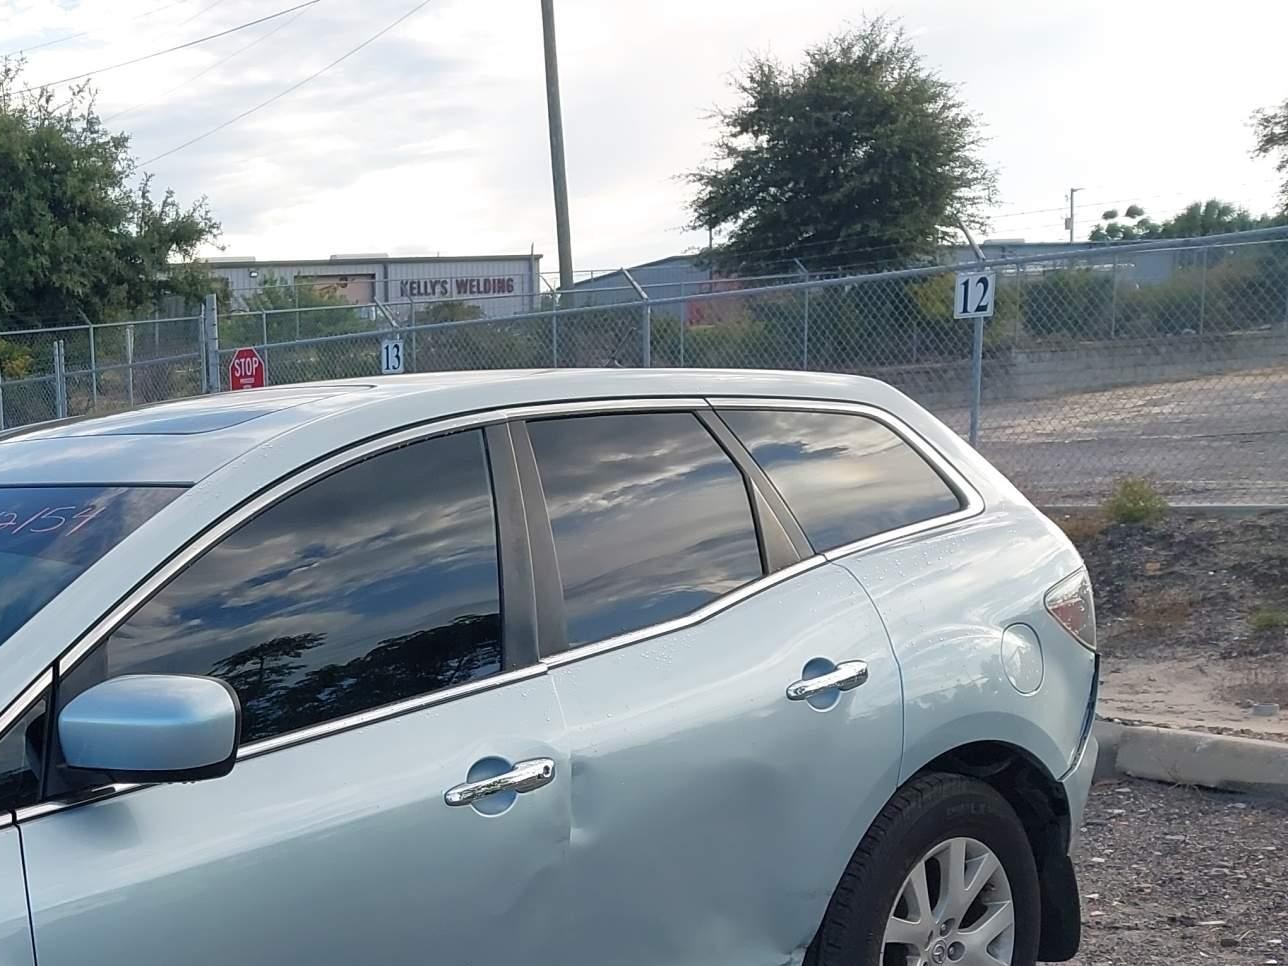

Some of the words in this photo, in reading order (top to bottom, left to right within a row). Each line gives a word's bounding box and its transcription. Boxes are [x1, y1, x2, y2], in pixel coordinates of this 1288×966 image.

[400, 279, 448, 297] KELLY'S
[455, 277, 514, 295] WELDING
[959, 276, 989, 314] 12
[234, 357, 259, 377] STOP
[383, 343, 401, 370] 13
